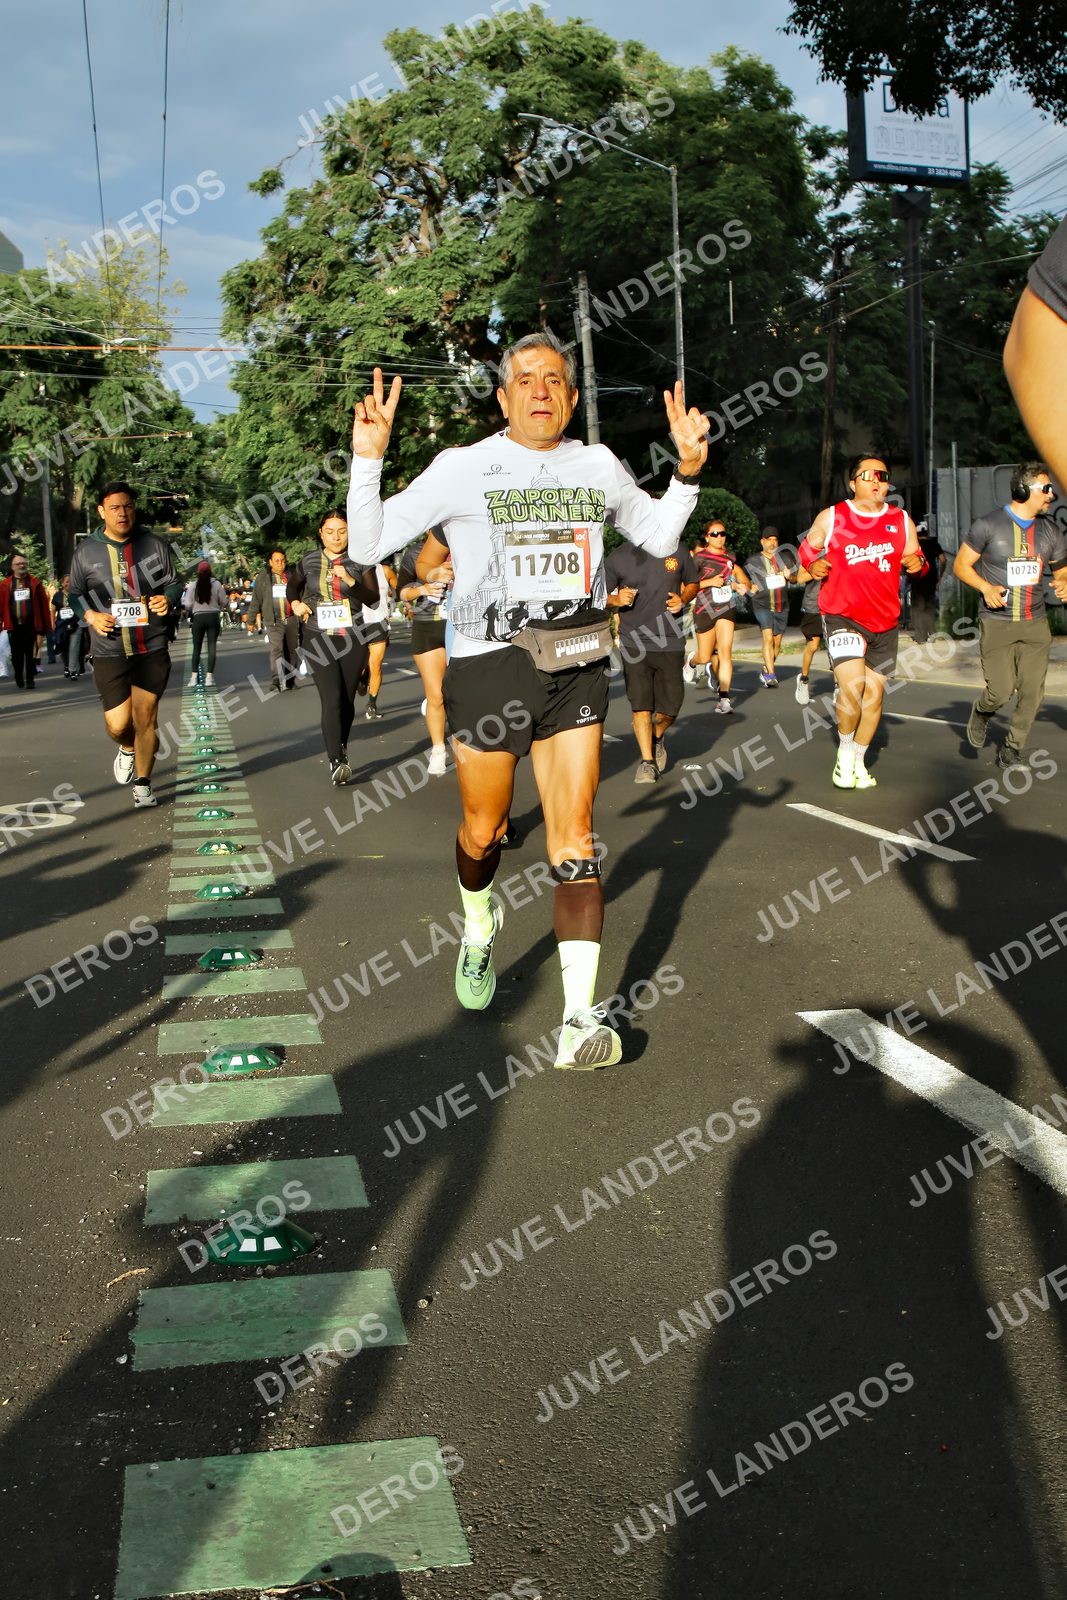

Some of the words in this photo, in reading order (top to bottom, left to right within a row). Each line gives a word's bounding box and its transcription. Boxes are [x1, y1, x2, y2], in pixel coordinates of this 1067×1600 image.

[484, 487, 606, 509] ZAPOPAN
[491, 503, 605, 524] RUNNERS
[845, 542, 895, 563] Dodgers
[511, 552, 580, 577] 11708
[1010, 565, 1038, 575] 10728
[117, 606, 141, 617] 5708
[322, 609, 343, 619] 5712
[832, 636, 861, 647] 12871
